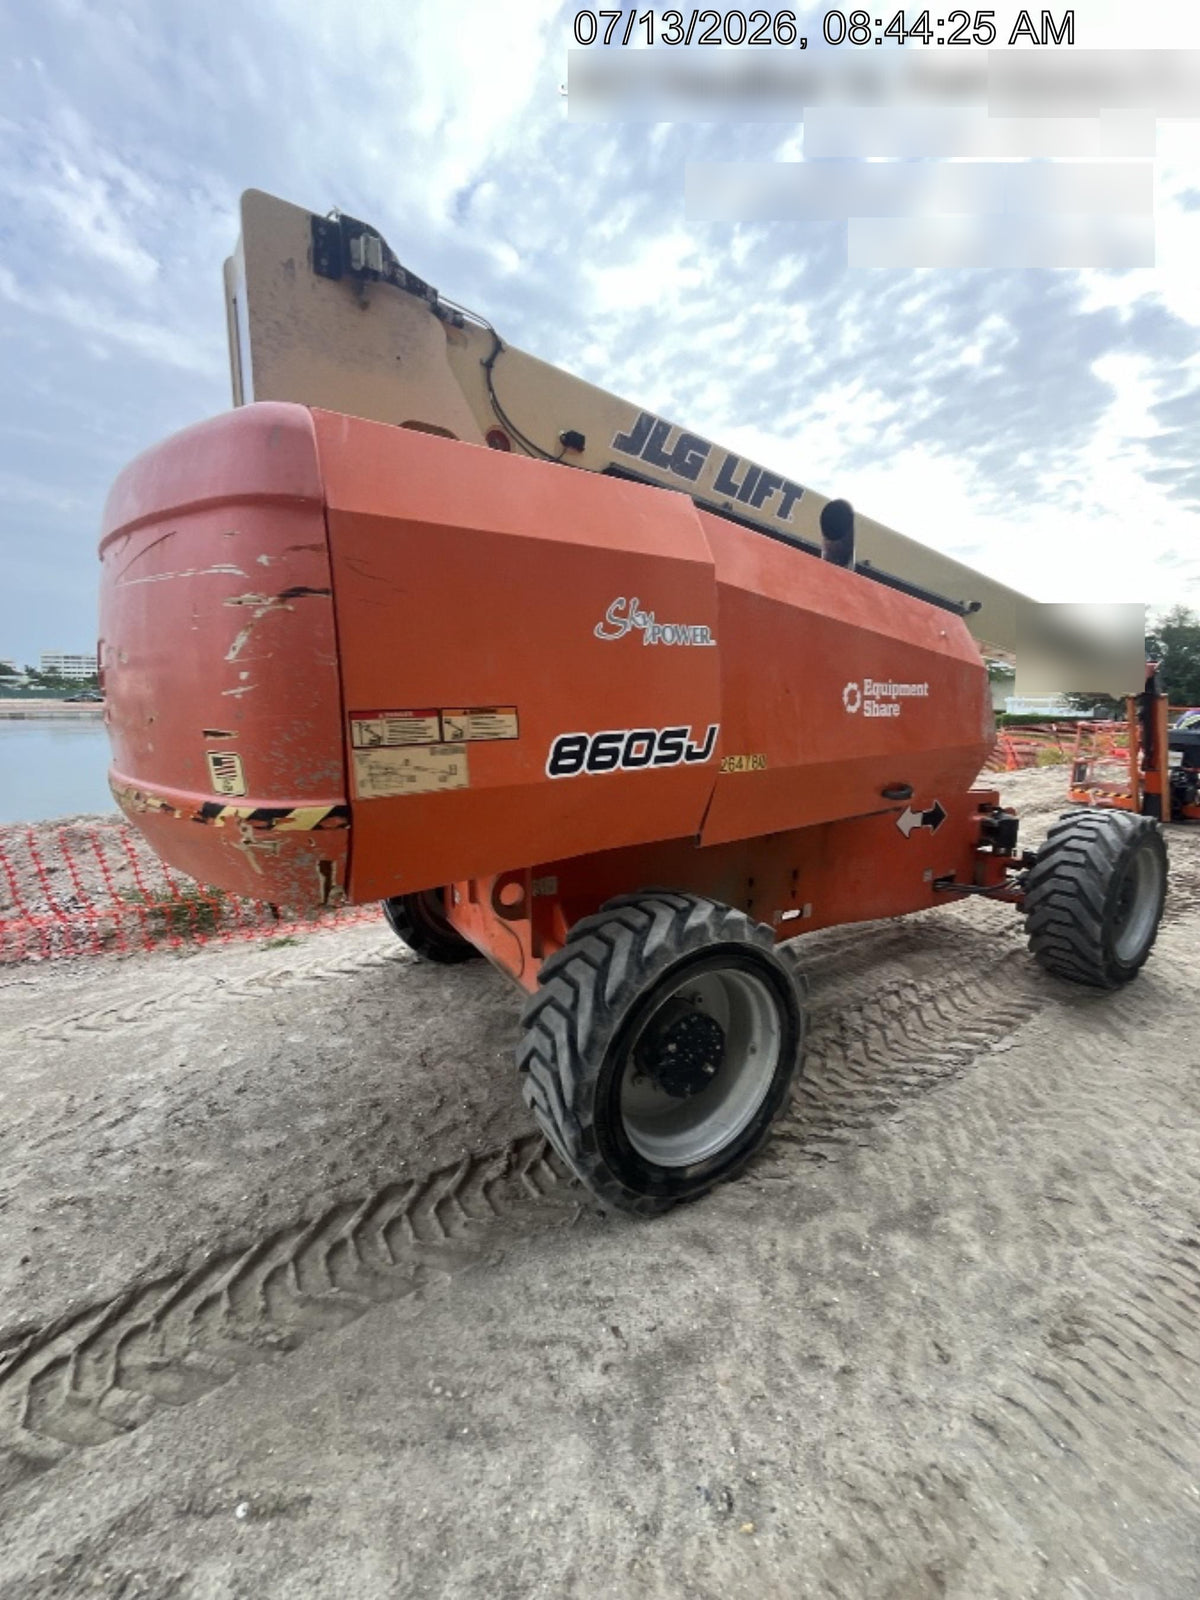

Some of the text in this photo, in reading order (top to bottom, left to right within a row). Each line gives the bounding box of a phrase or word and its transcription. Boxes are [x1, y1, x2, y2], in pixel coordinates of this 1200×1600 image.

[611, 411, 805, 522] JLG LIFT
[593, 597, 655, 646] Sky
[650, 624, 717, 646] POWER
[863, 679, 929, 700] Equipment
[863, 700, 901, 717] Share
[546, 724, 720, 780] 860SJ
